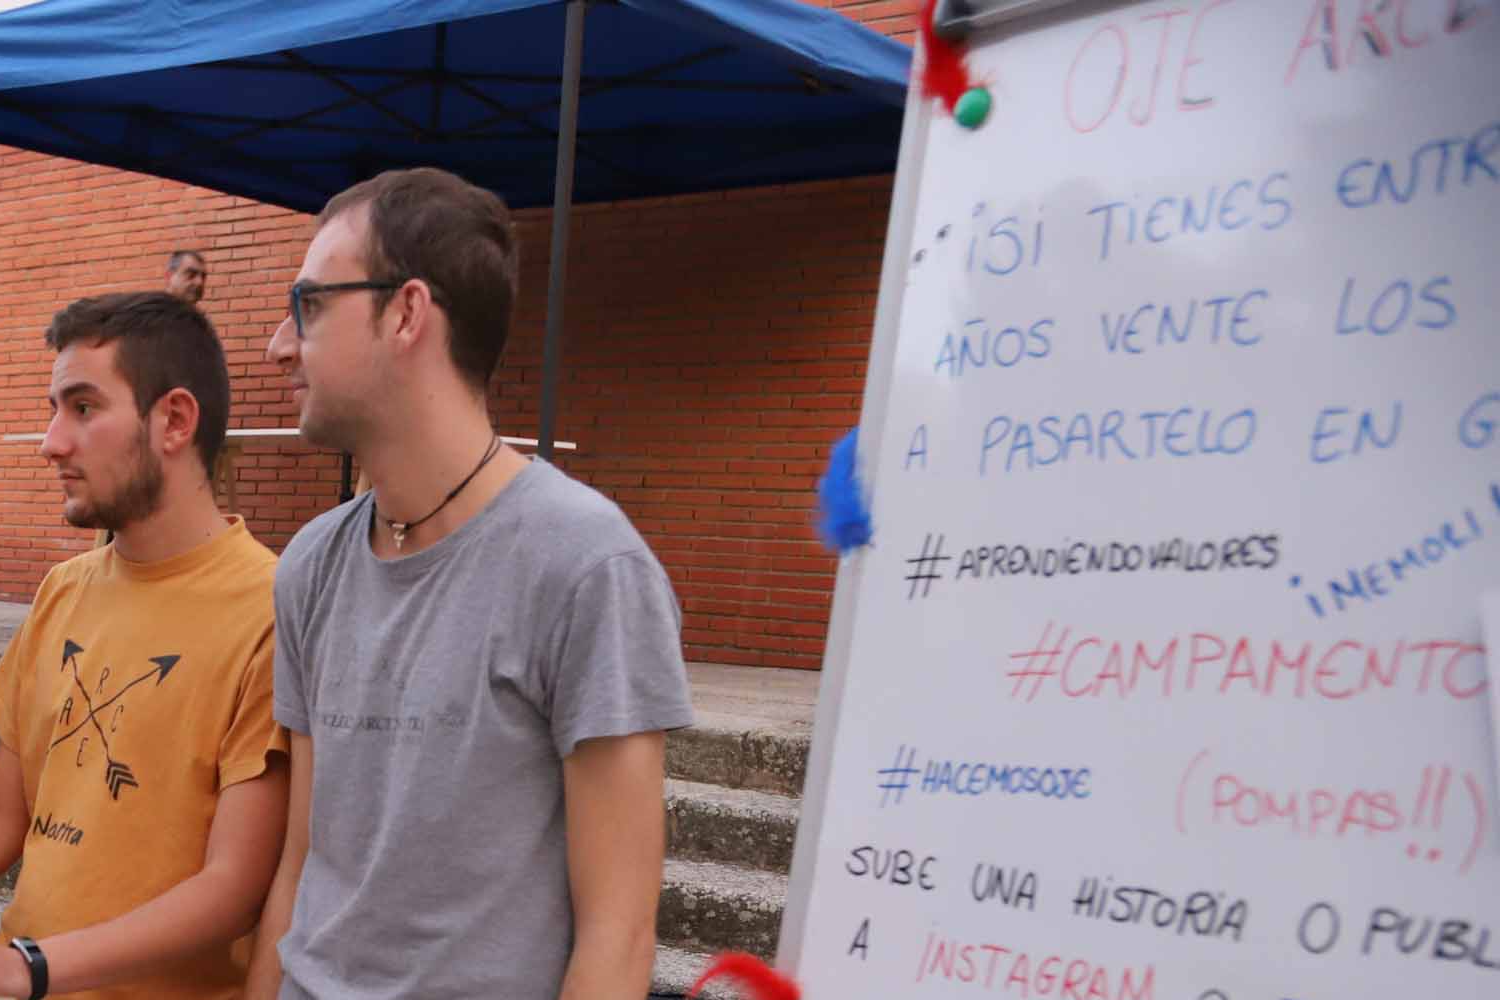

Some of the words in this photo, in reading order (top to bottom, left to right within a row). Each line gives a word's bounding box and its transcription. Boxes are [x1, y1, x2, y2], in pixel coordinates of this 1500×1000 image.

[1085, 171, 1295, 261] TIENES
[933, 317, 1057, 377] AÑOS
[1100, 288, 1270, 355] VENTE
[1335, 276, 1458, 337] LOS
[902, 423, 928, 472] A
[977, 406, 1258, 476] PASARTELO
[1308, 400, 1402, 464] EN
[845, 845, 939, 892] SUBE
[971, 861, 1039, 913] UNA
[1071, 875, 1250, 943] HISTORIA
[1296, 900, 1341, 955] O
[847, 917, 871, 960] A
